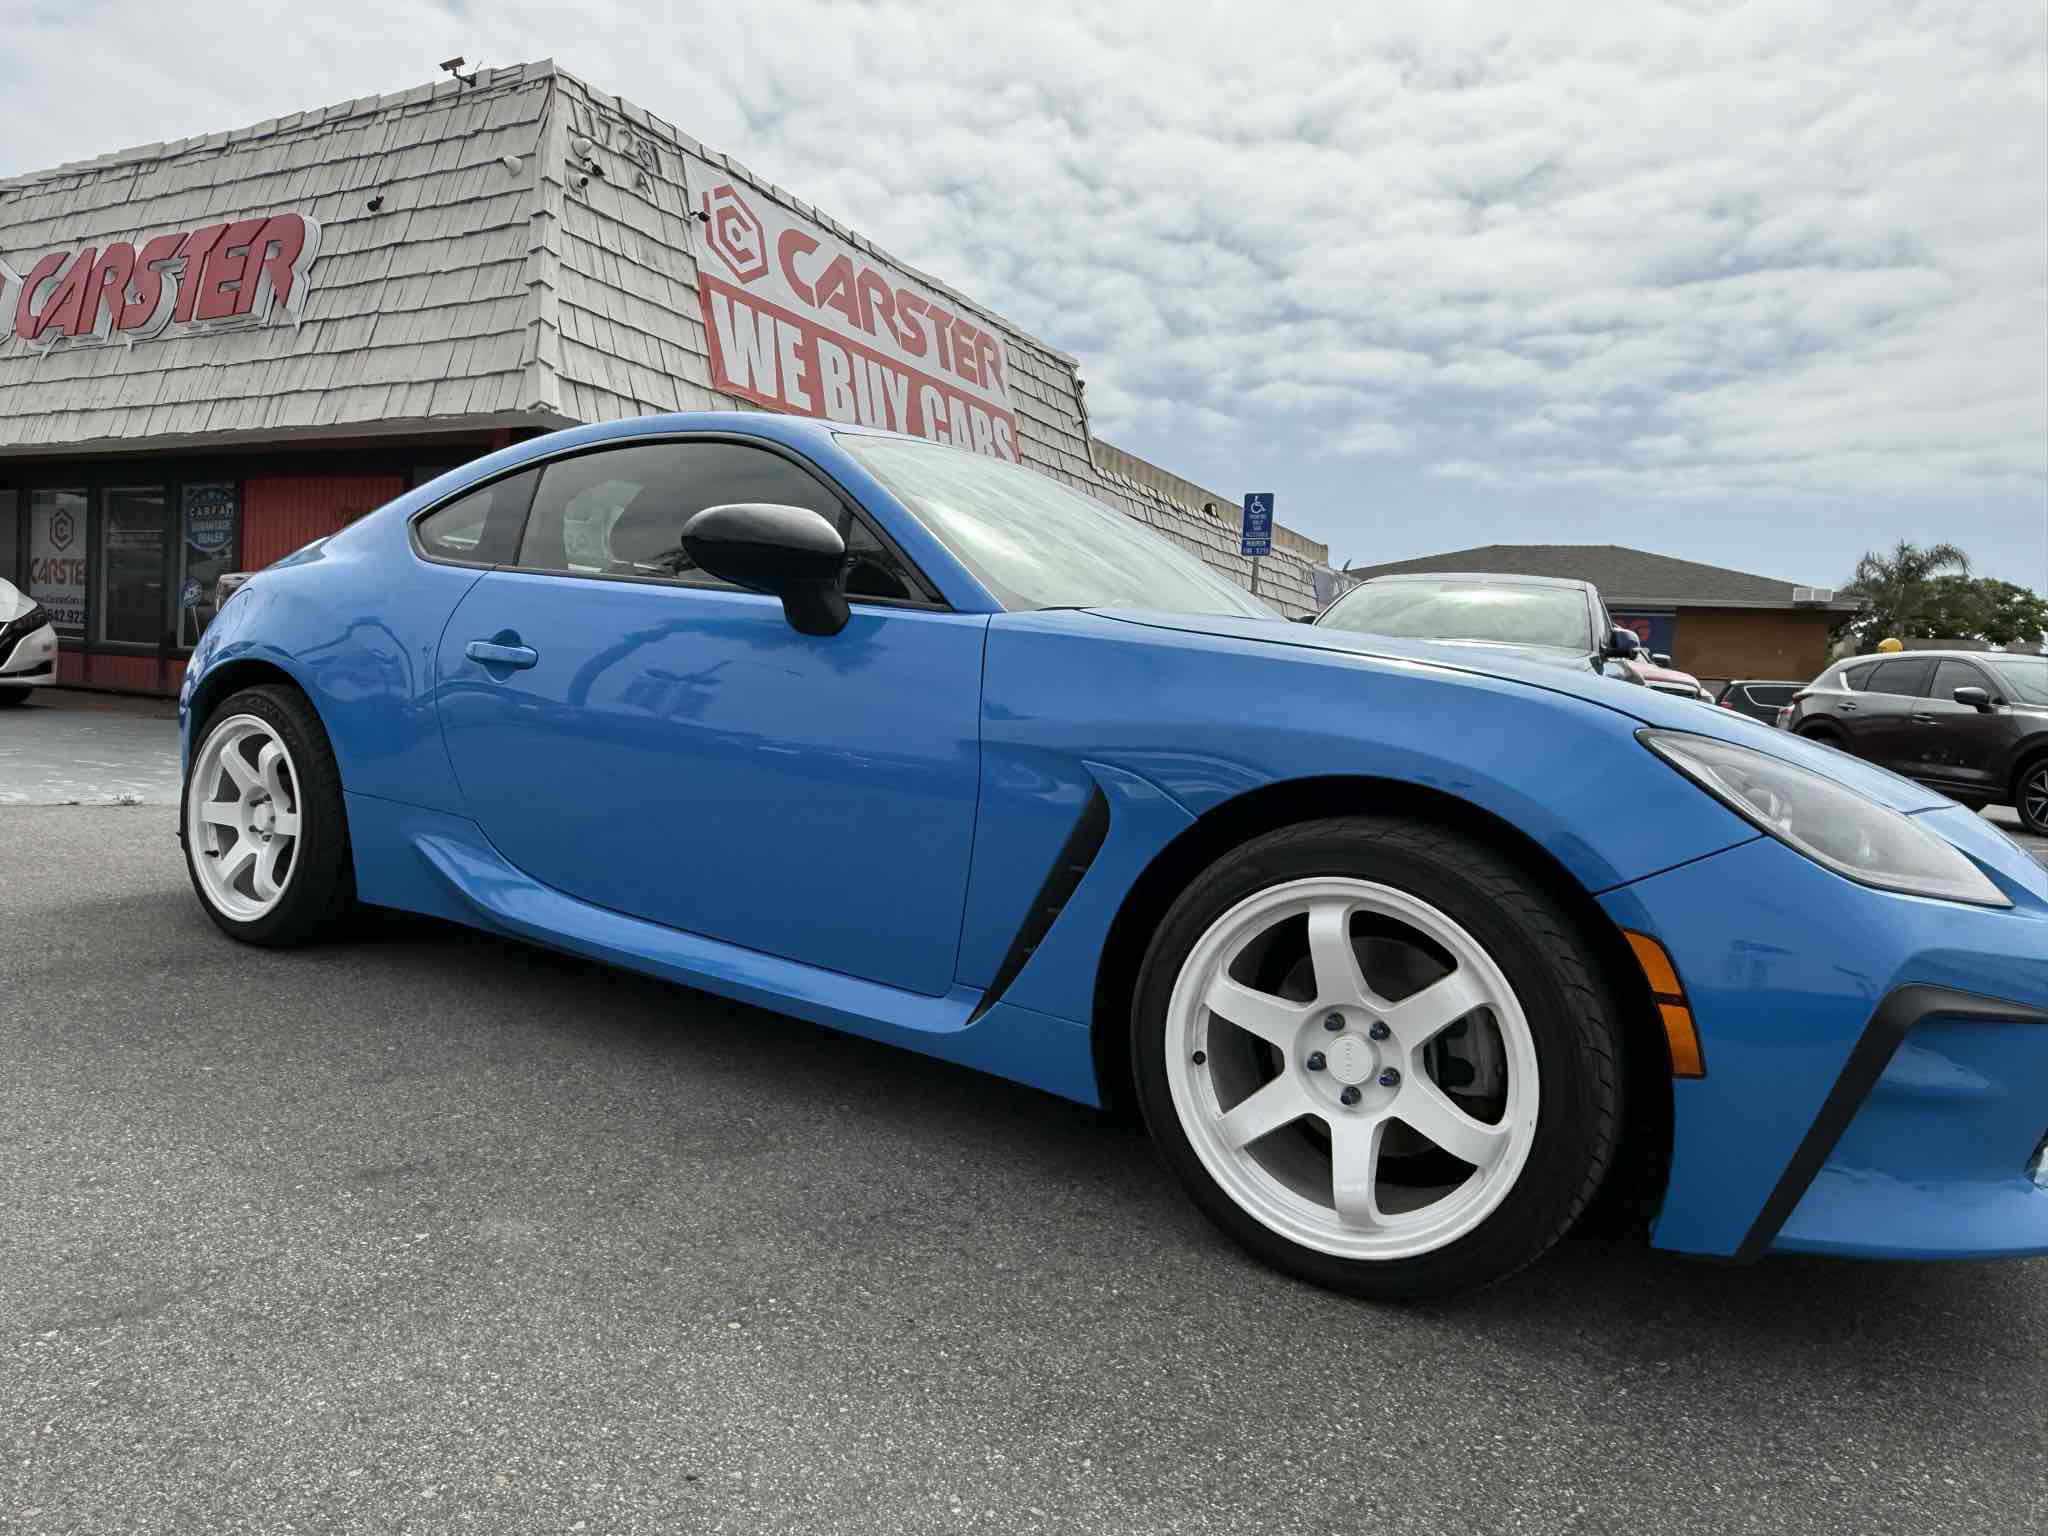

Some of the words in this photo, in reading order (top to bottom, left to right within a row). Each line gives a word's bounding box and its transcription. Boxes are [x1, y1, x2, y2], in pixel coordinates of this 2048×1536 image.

[16, 212, 308, 341] CARSTER
[777, 227, 1006, 398] CARSTER
[709, 289, 813, 412] WE
[816, 336, 910, 434] BUY
[918, 384, 1019, 465] CARS
